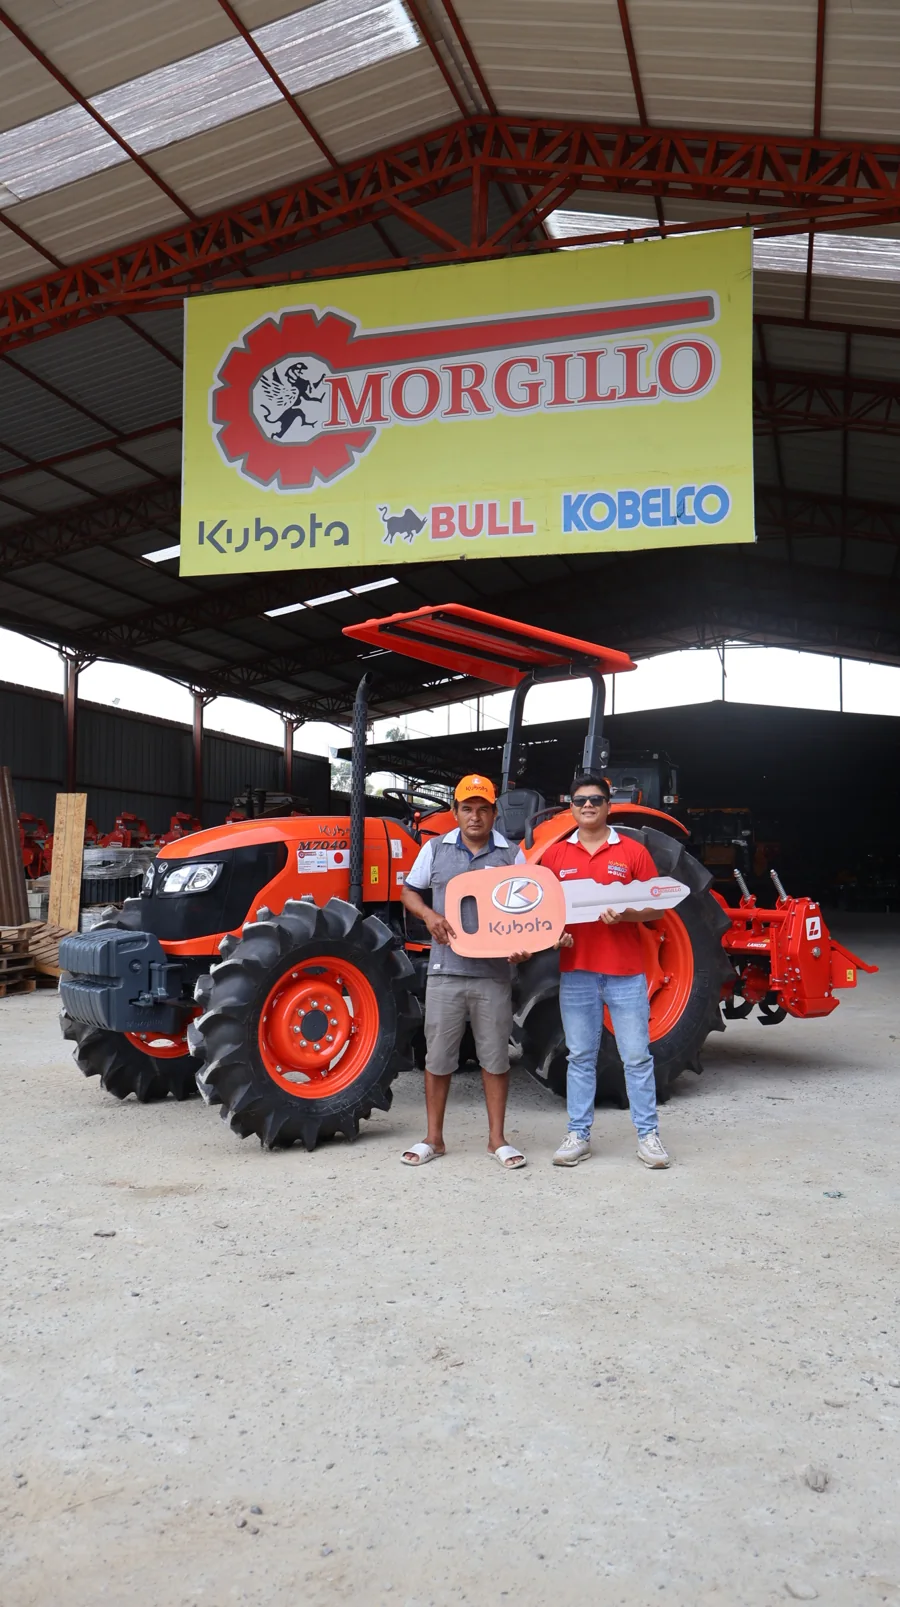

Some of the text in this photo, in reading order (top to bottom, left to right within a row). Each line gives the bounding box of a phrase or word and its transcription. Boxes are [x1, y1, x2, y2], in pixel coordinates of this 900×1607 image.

[322, 340, 714, 428] MORGILLO
[431, 500, 534, 539] BULL
[563, 484, 730, 532] KOBELCO
[198, 513, 349, 553] Kubota
[297, 841, 348, 850] M7040
[489, 917, 553, 935] Kubota
